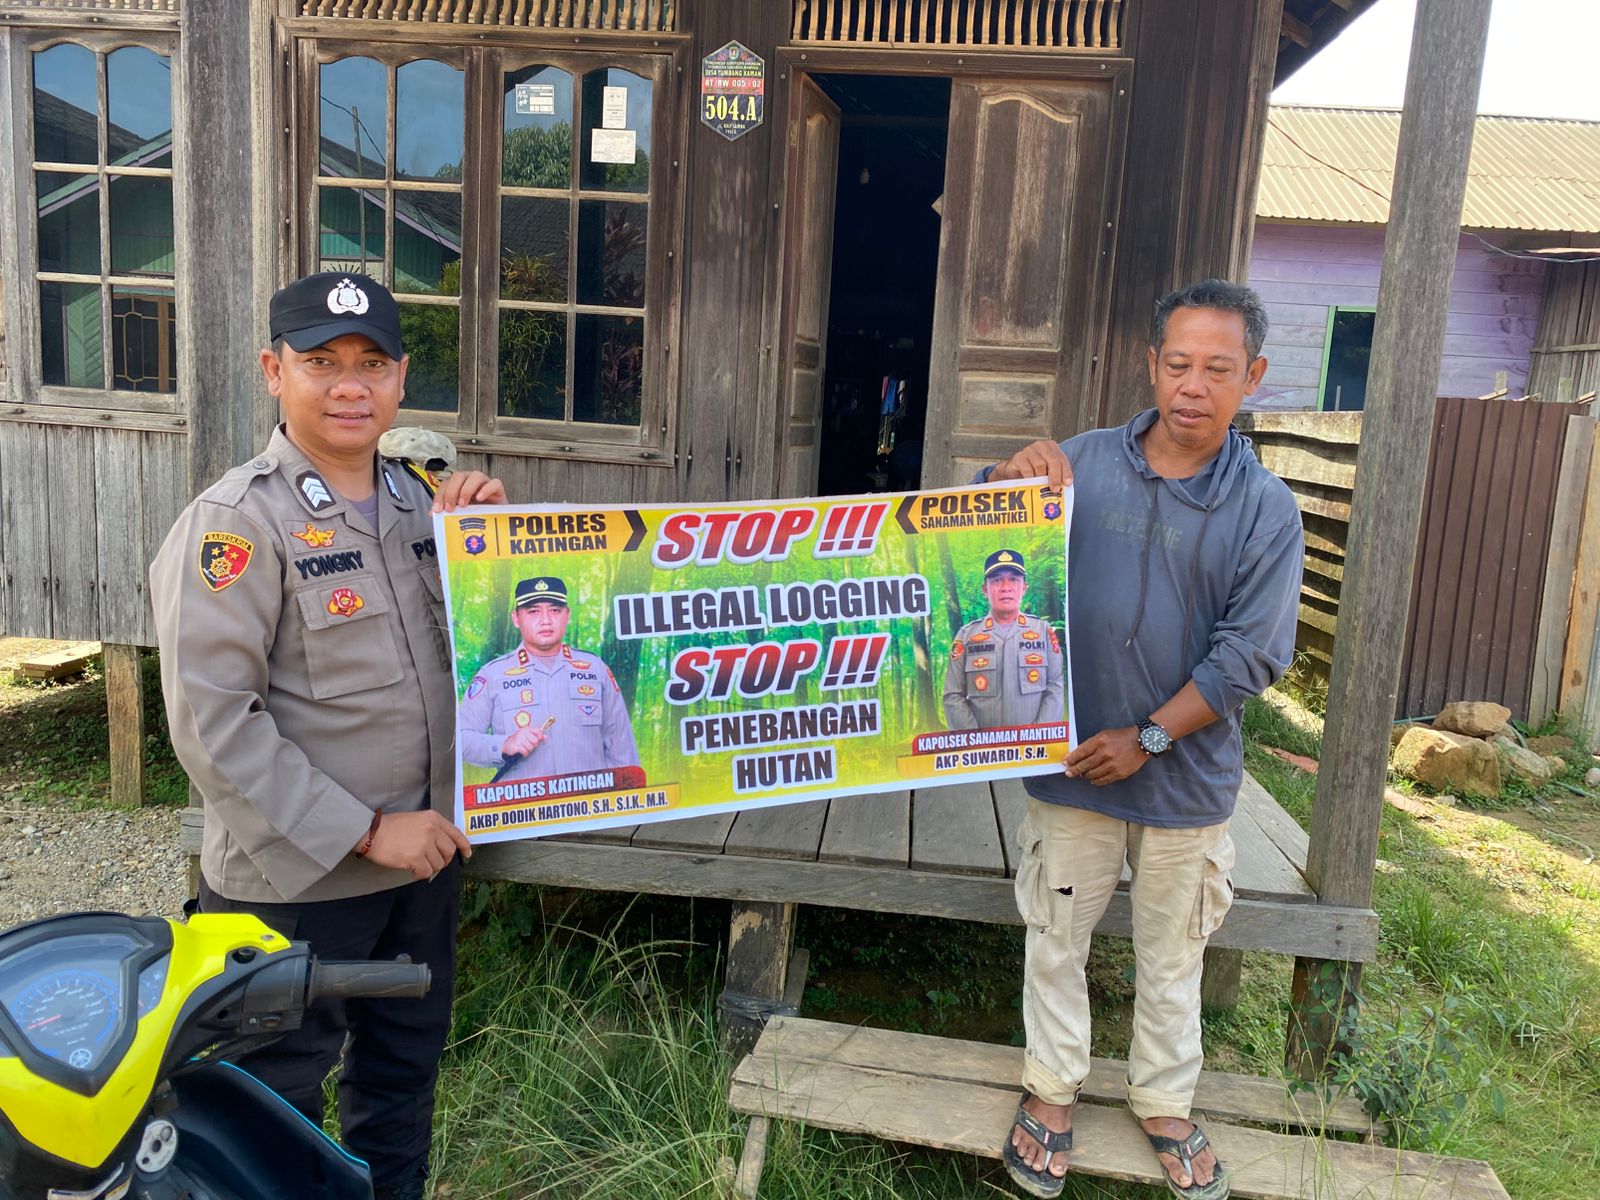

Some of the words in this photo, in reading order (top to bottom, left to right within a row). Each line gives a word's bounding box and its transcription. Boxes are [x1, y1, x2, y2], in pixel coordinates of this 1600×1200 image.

[732, 79, 746, 88] 005
[752, 80, 761, 88] 02
[705, 95, 757, 121] 504.A
[921, 490, 1027, 516] POLSEK
[508, 513, 607, 537] POLRES
[656, 509, 815, 562] STOP
[820, 503, 889, 552] !!!
[921, 514, 974, 529] SANAMAN
[976, 511, 1028, 526] MANTIKEI
[509, 534, 608, 554] KATINGAN
[294, 550, 364, 580] YONGKY
[618, 590, 762, 636] ILLEGAL
[769, 577, 927, 624] LOGGING
[1019, 641, 1046, 650] POLRI
[570, 672, 598, 681] POLRI
[668, 642, 818, 701] STOP
[823, 636, 888, 687] !!!
[503, 678, 532, 689] DODIK
[685, 702, 877, 751] PENEBANGAN
[918, 734, 968, 751] KAPOLSEK
[969, 730, 1018, 745] SANAMAN
[1019, 726, 1067, 741] MANTIKEI
[736, 750, 833, 789] HUTAN
[935, 755, 960, 769] AKP
[962, 748, 1022, 766] SUWARDI,
[1024, 747, 1048, 760] S.H.
[476, 783, 546, 804] KAPOLRES
[548, 772, 614, 794] KATINGAN
[469, 813, 500, 830] AKBP
[501, 808, 536, 826] DODIK
[538, 801, 591, 820] HARTONO,
[592, 797, 615, 815] S.H.,
[616, 794, 645, 812] S.I.K.,
[646, 791, 668, 808] M.H.
